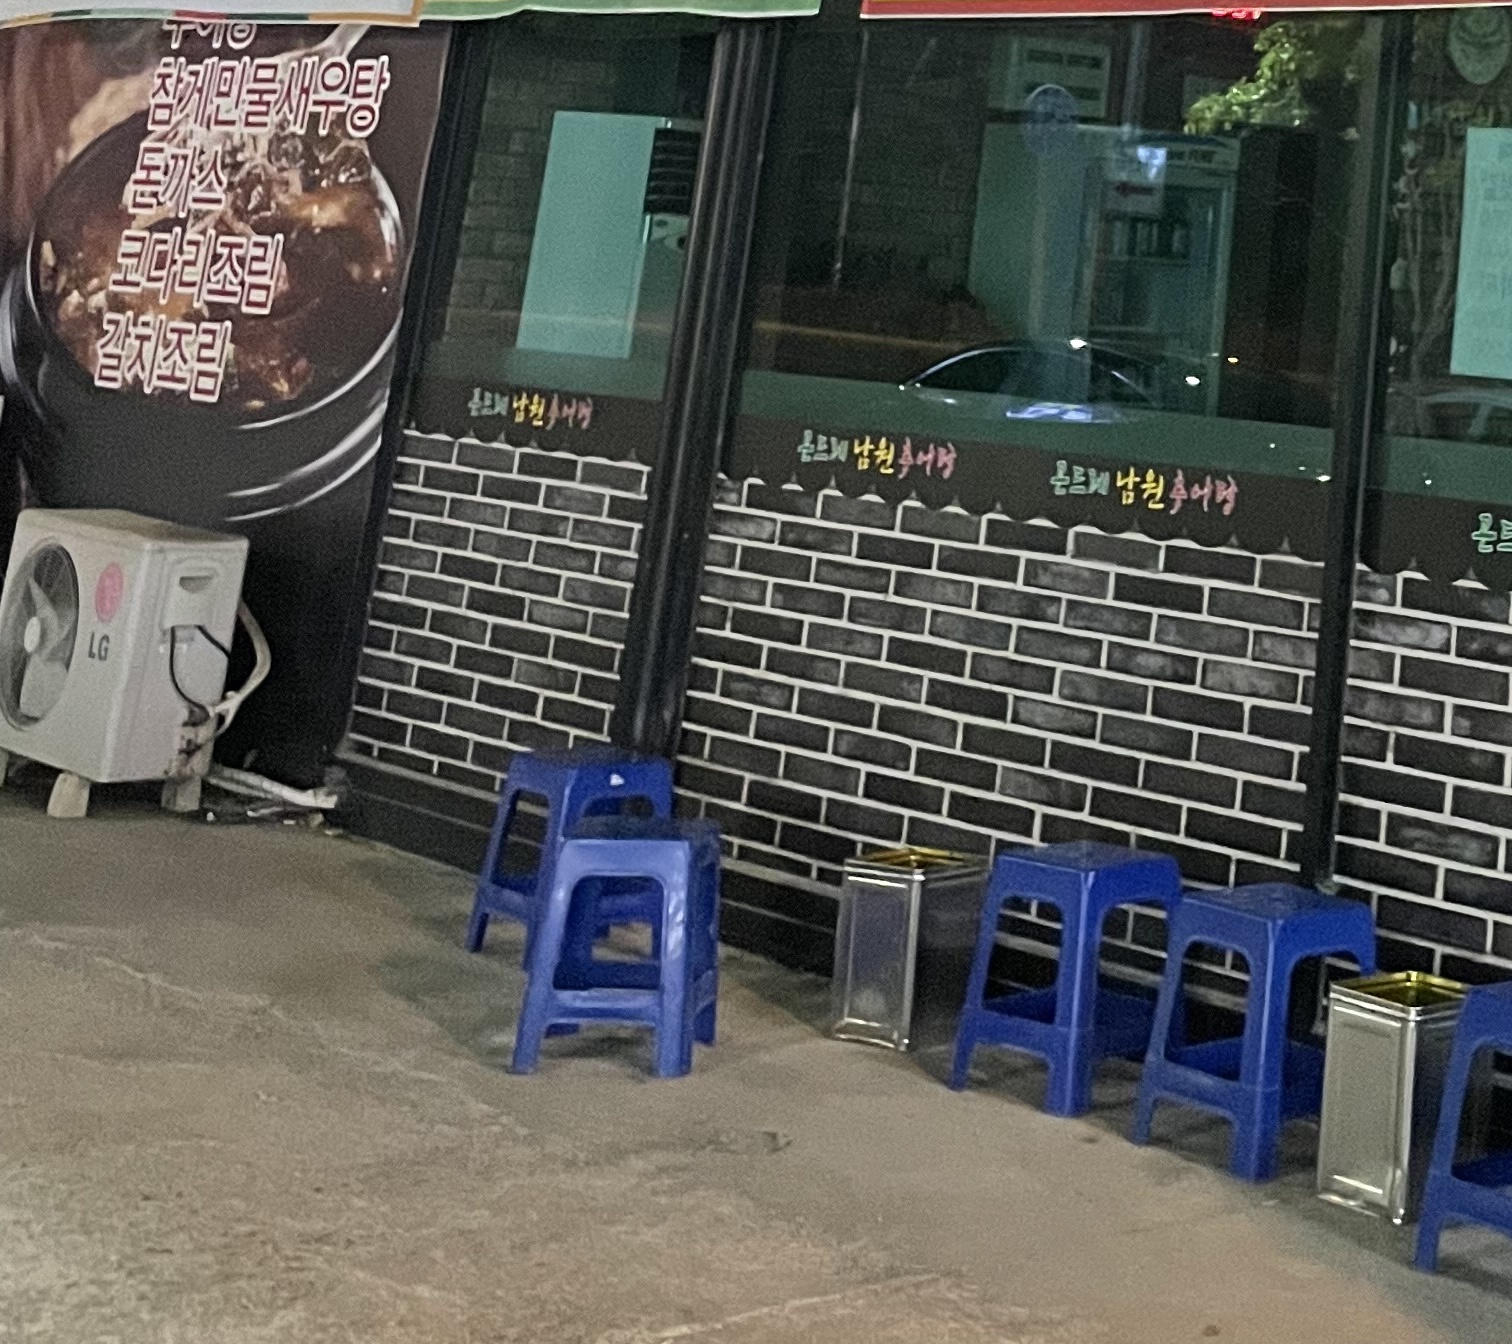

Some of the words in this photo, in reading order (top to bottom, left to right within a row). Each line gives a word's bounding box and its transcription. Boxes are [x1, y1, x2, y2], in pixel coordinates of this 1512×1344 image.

[147, 55, 391, 138] 참게민물새우탕
[127, 142, 228, 218] 돈까스
[108, 227, 285, 315] 코다리조림
[94, 310, 233, 403] 갈치조림
[1116, 466, 1165, 509] 남원
[88, 631, 111, 662] LG
